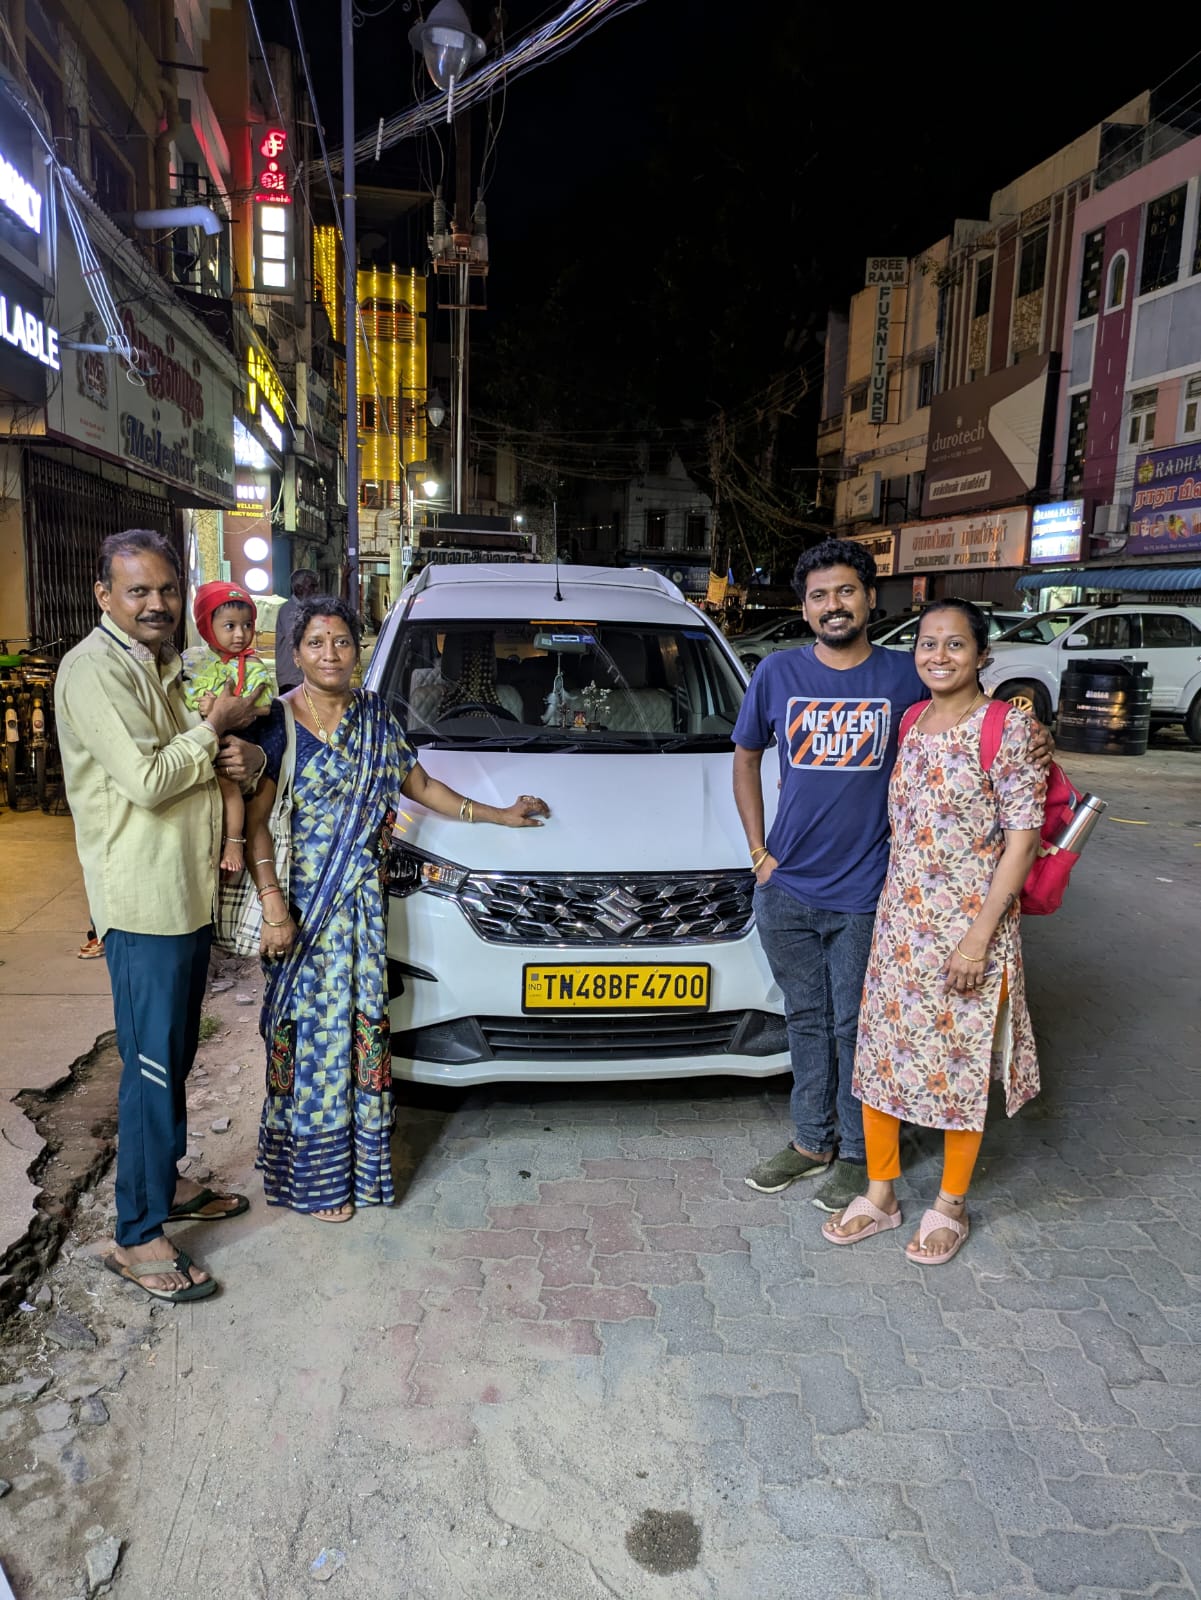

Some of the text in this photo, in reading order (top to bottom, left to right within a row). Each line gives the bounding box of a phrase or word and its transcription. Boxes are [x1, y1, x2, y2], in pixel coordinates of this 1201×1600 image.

[872, 259, 903, 271] SREE
[868, 271, 904, 283] RAAM
[0, 294, 60, 371] LABLE
[871, 286, 891, 421] FURNITURE
[932, 419, 985, 452] durotech
[1155, 454, 1201, 479] RADHA
[1133, 486, 1177, 512] ராதா
[914, 550, 1001, 567] CHAMPION FURNITURE
[801, 710, 874, 732] NEVER
[811, 733, 863, 756] QUIT
[528, 983, 542, 991] IND
